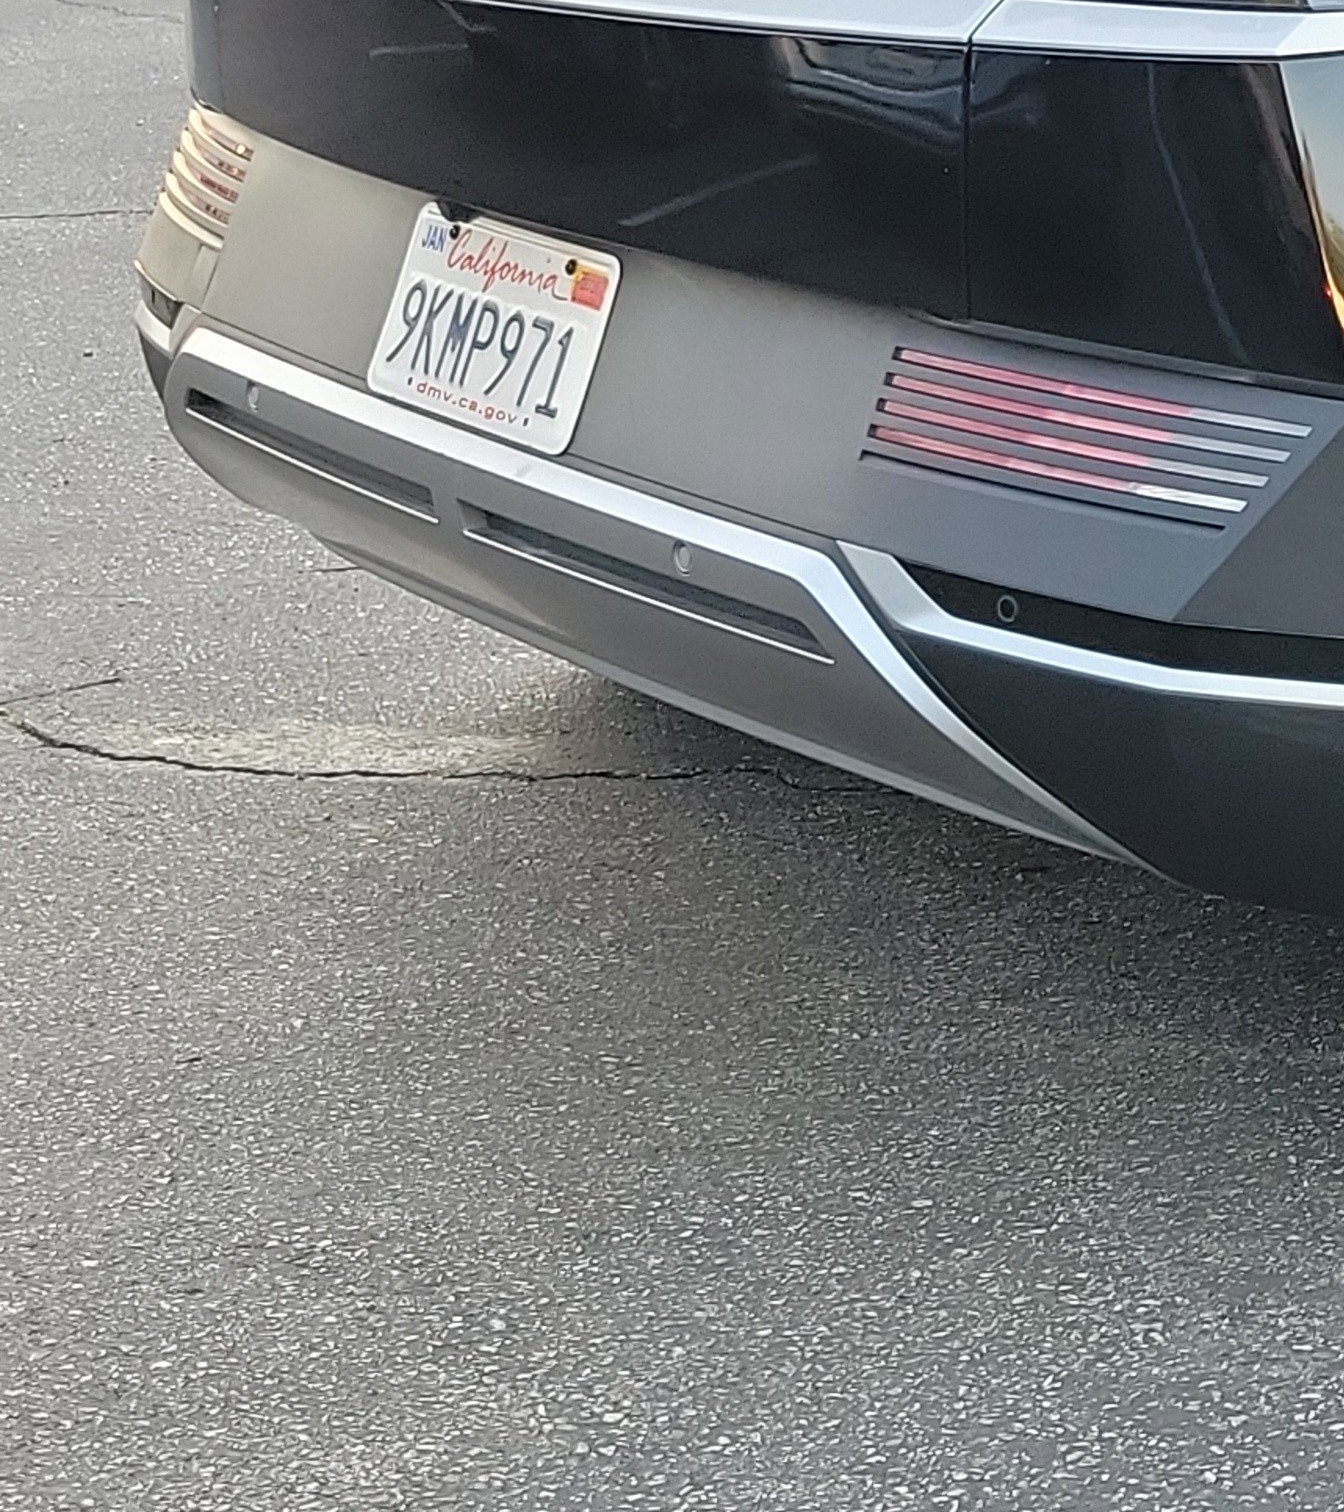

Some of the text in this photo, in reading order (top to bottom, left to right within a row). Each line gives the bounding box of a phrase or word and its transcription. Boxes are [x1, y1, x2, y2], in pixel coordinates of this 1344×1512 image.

[421, 224, 449, 253] JAN
[446, 228, 568, 301] California
[385, 278, 574, 419] 9KMP971
[416, 380, 518, 425] dmv.ca.gov
